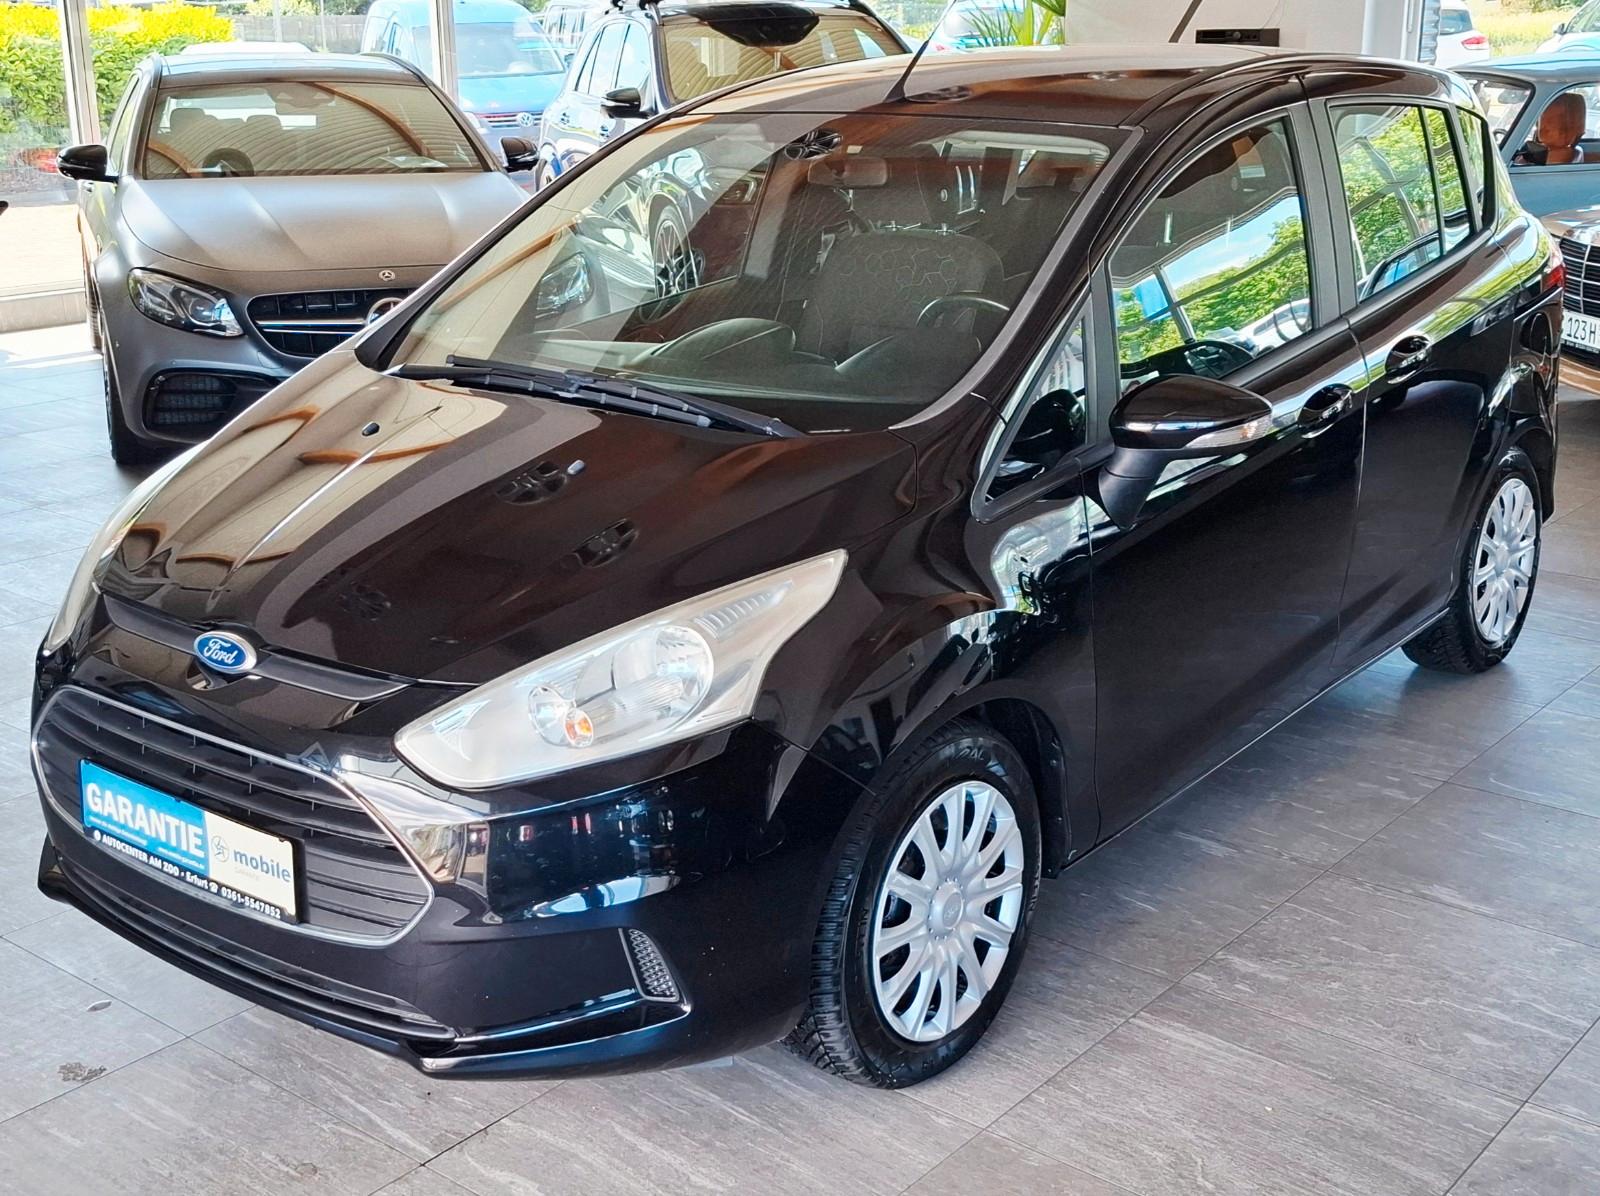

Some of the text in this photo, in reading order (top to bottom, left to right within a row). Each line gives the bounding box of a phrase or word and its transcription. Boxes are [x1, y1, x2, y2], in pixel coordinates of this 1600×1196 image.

[203, 638, 238, 664] Ford
[86, 783, 205, 858] GARANTIE
[102, 834, 148, 863] AUTOCENTER
[149, 856, 162, 868] AM
[163, 861, 179, 876] ZOO
[186, 872, 208, 889] Erfurt
[221, 886, 281, 919] 0361-5547852
[234, 849, 291, 882] mobile
